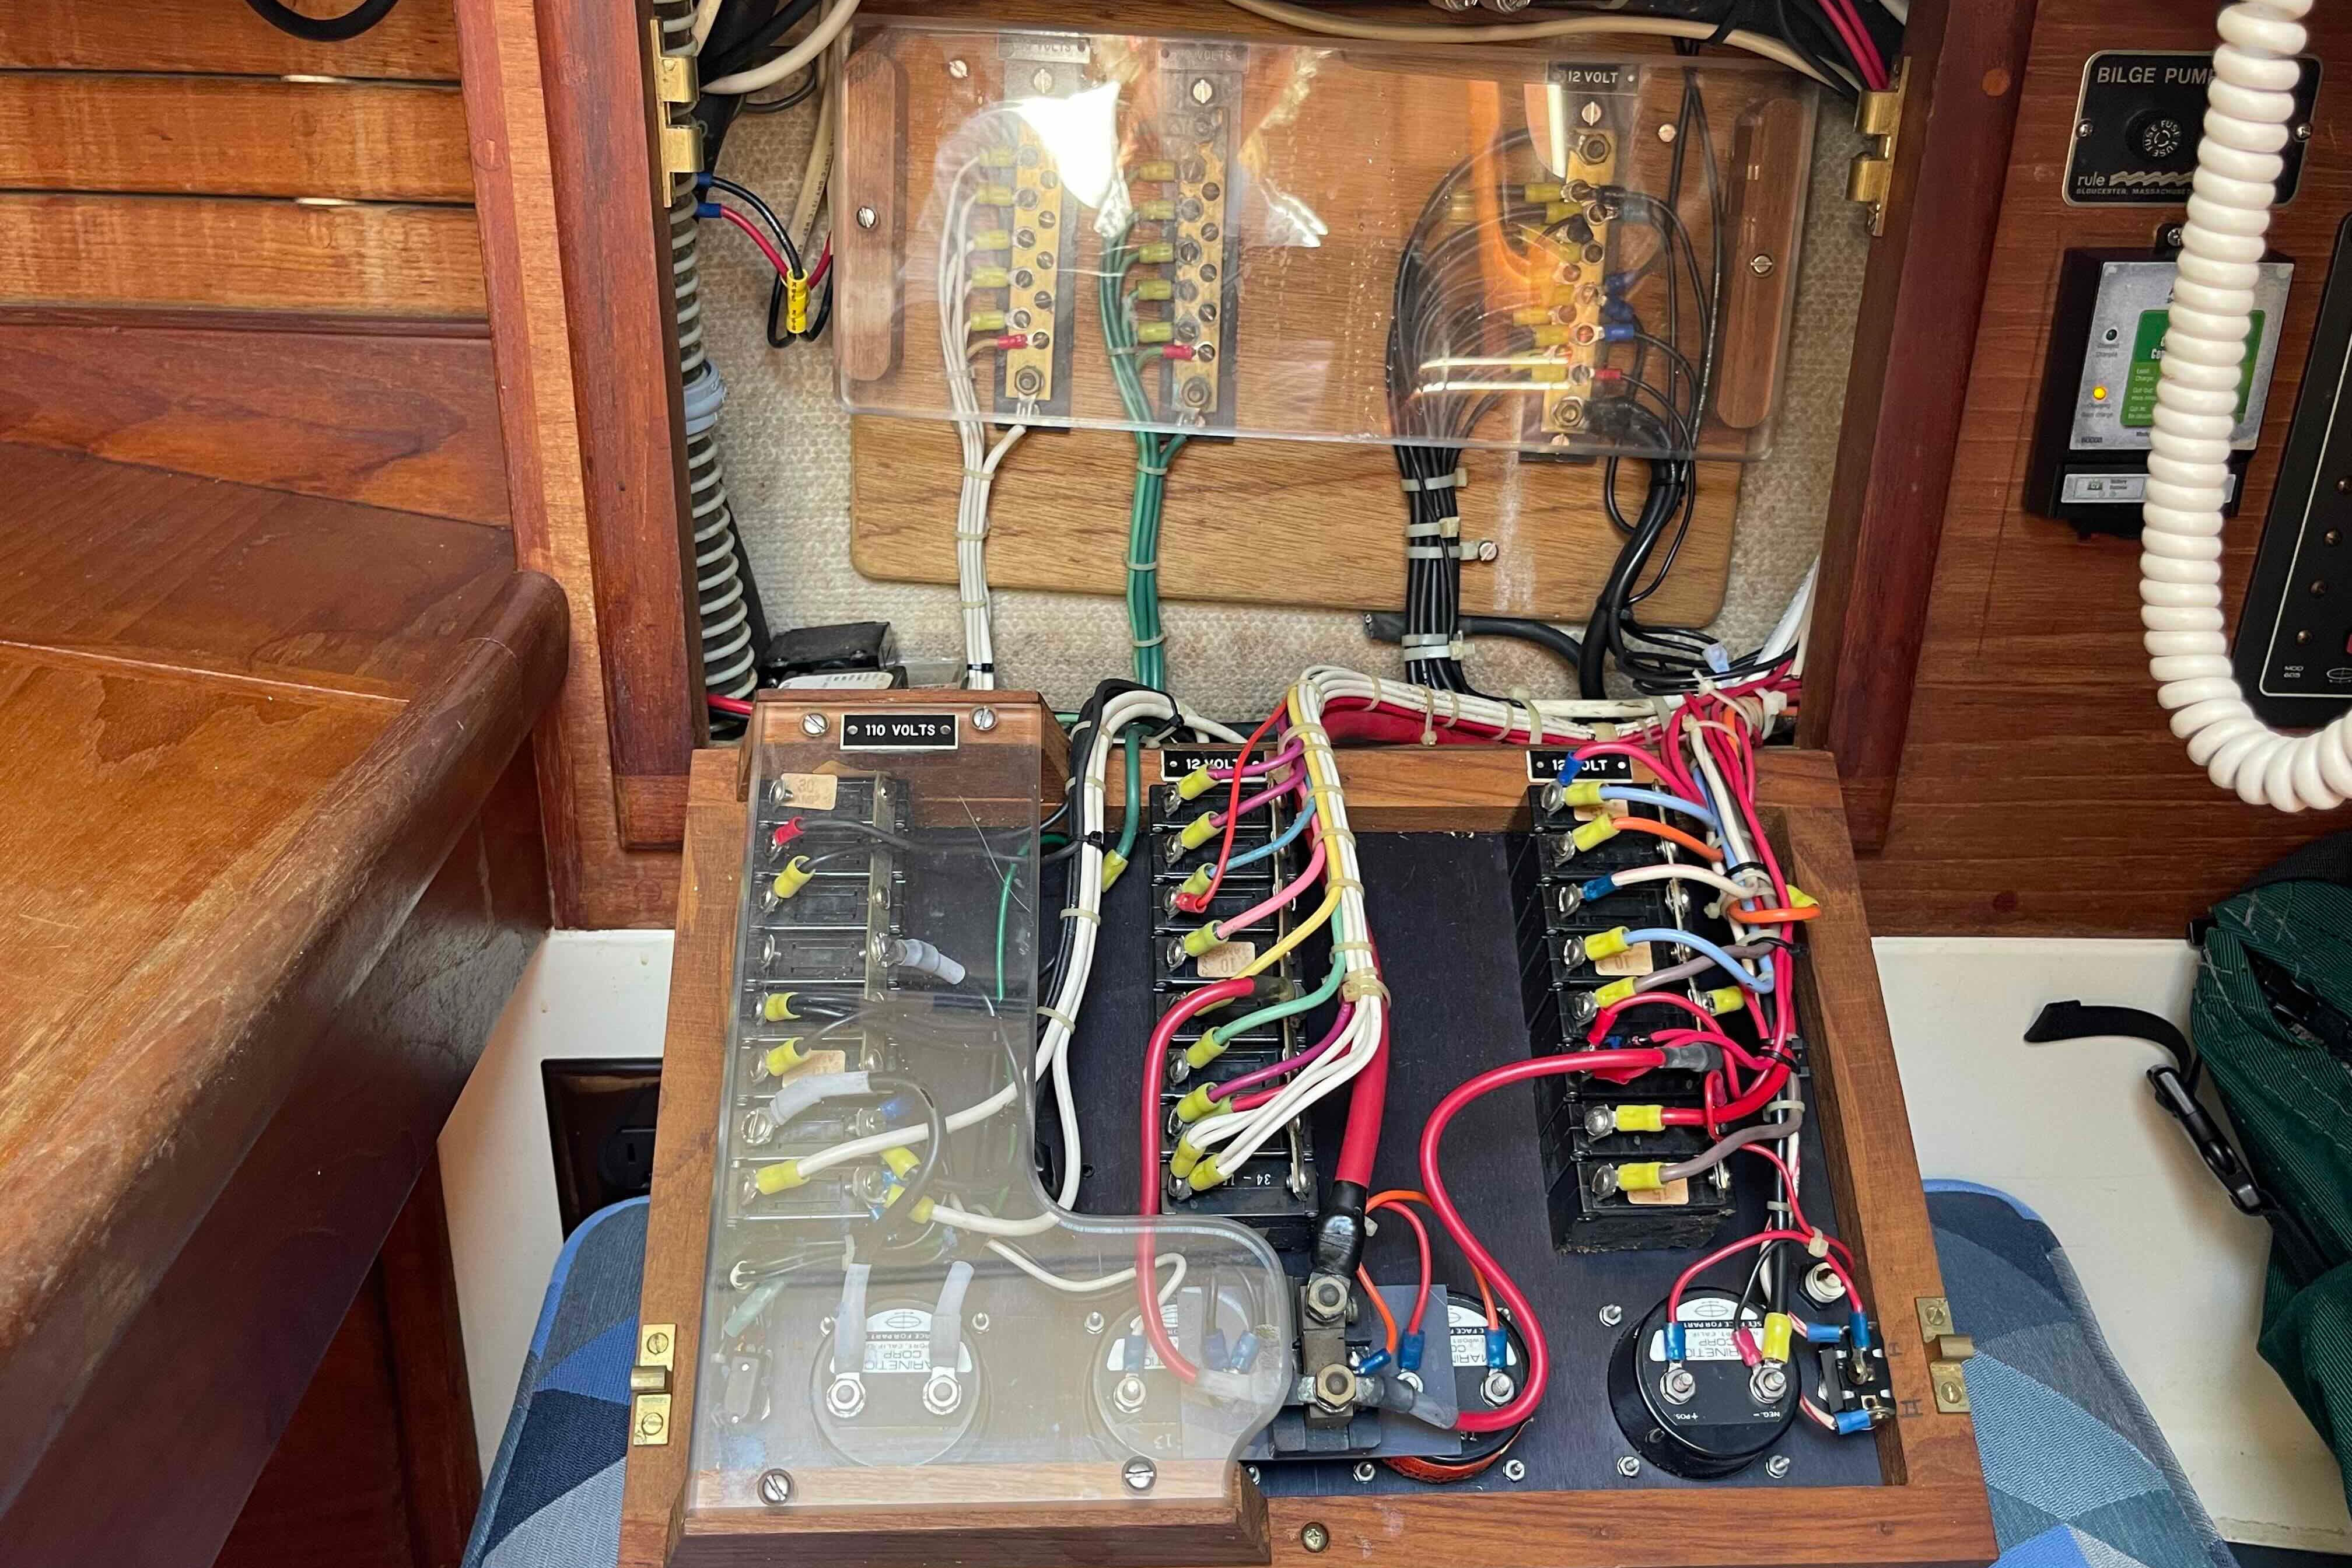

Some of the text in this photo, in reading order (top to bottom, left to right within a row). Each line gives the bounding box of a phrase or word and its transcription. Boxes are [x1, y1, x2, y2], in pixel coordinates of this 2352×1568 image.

[1567, 70, 1618, 84] 12 VOLT
[2097, 66, 2157, 83] BILGE
[2077, 172, 2105, 186] rule
[865, 723, 936, 737] 110 VOLTS
[1186, 758, 1200, 770] 12
[1256, 1173, 1271, 1186] 34
